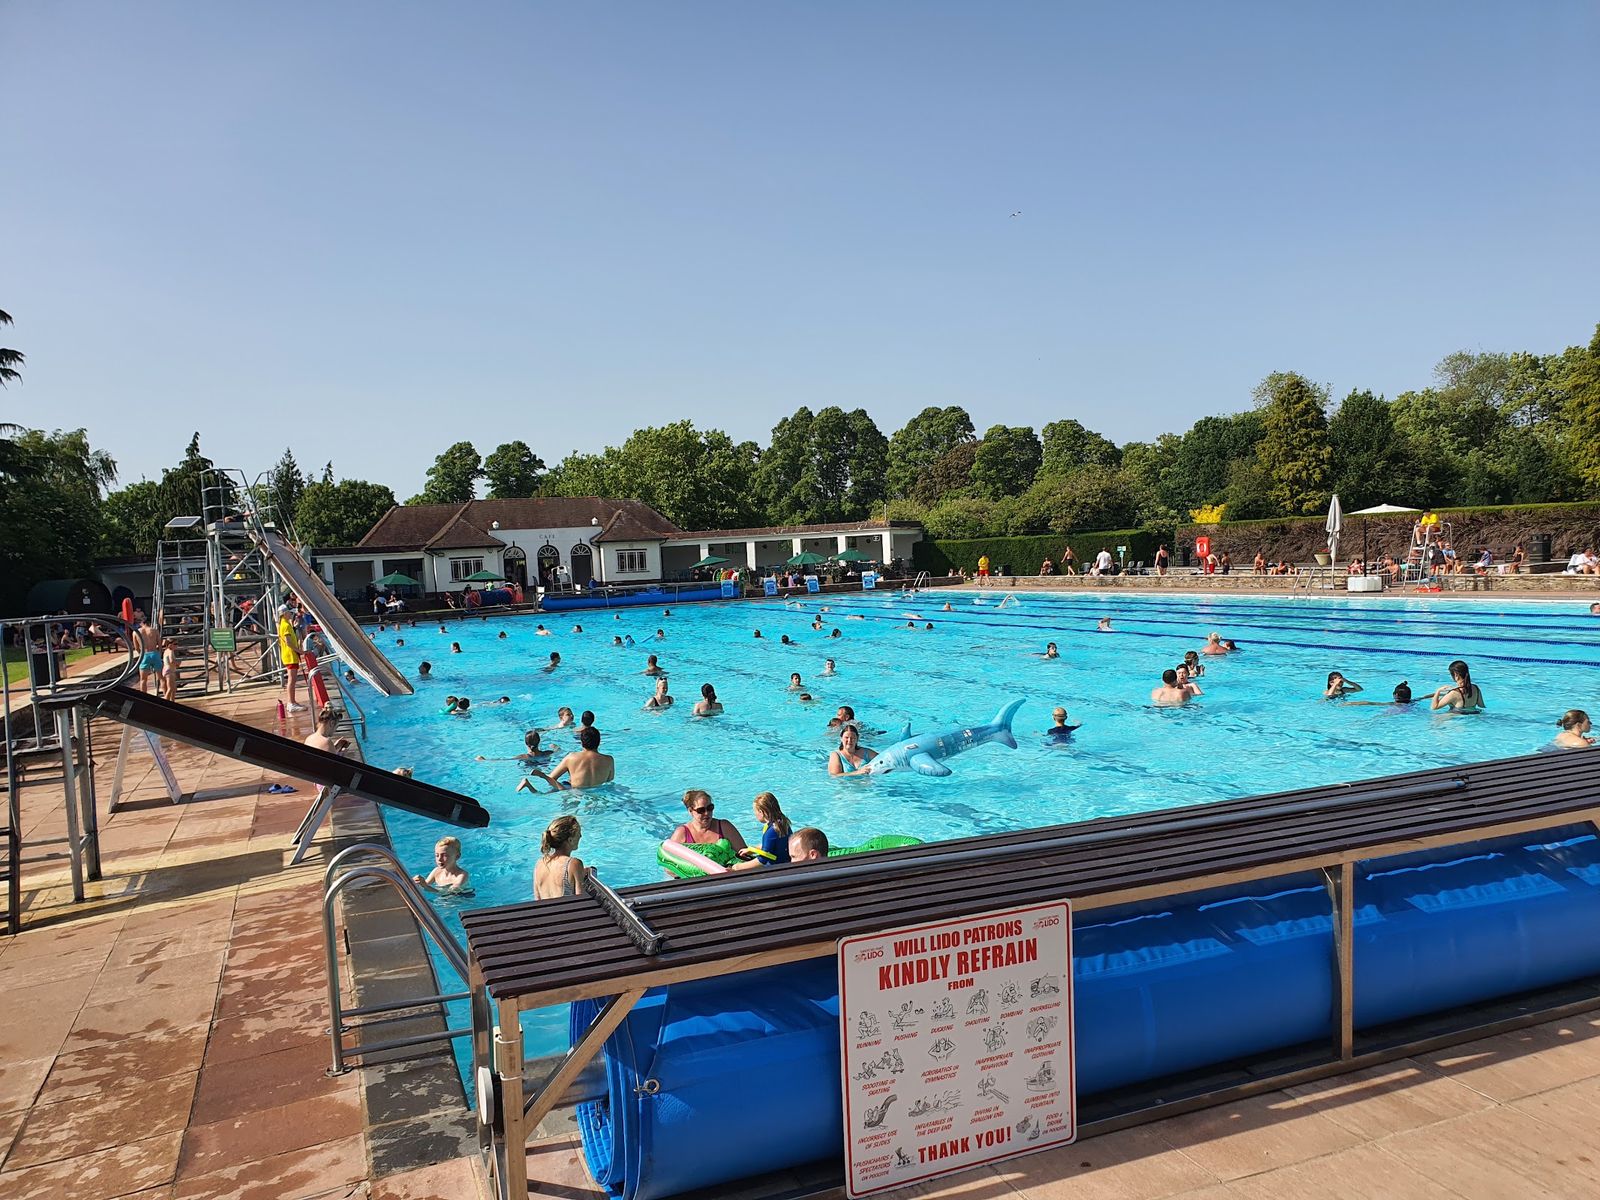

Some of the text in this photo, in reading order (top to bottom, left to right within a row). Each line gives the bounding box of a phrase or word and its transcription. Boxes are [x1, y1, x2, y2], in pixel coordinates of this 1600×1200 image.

[1044, 918, 1060, 927] LIDO
[893, 920, 1023, 957] WILL LIDO PATRONS
[867, 950, 884, 960] LIDO
[879, 938, 1037, 991] KINDLY REFRAIN
[948, 978, 974, 990] FROM
[1029, 1001, 1061, 1013] SNORKELLING
[1000, 1009, 1024, 1019] BOMBING
[964, 1016, 990, 1027] SHOUTING
[930, 1024, 954, 1034] DUCKING
[894, 1031, 918, 1041] PUSHING
[856, 1039, 882, 1049] RUNNING
[1024, 1040, 1062, 1054] INAPPROPRIATE
[974, 1052, 1014, 1066] INAPPROPRIATE
[1031, 1049, 1055, 1060] CLOTHING
[980, 1060, 1009, 1072] BEHAVIOUR
[921, 1066, 952, 1078] ACROBATICS
[924, 1071, 957, 1084] GYMNASTICS
[861, 1080, 888, 1091] SCOOTING
[867, 1086, 891, 1097] SKATING
[1024, 1090, 1061, 1104] CLIMBING INTO
[1030, 1100, 1055, 1109] FOUNTAIN
[970, 1111, 1005, 1125] SHALLOW END
[974, 1108, 992, 1117] DIVING
[1045, 1113, 1059, 1121] FOOD
[914, 1118, 946, 1131] INFLATABLES
[1046, 1119, 1062, 1127] DRINK
[927, 1127, 940, 1135] DEEP
[941, 1124, 952, 1132] END
[857, 1133, 886, 1145] INCORRECT
[873, 1139, 891, 1148] SLIDES
[918, 1126, 1011, 1164] THANK YOU!
[856, 1155, 889, 1169] PUSHCHAIRS
[859, 1162, 891, 1174] SPECTATORS
